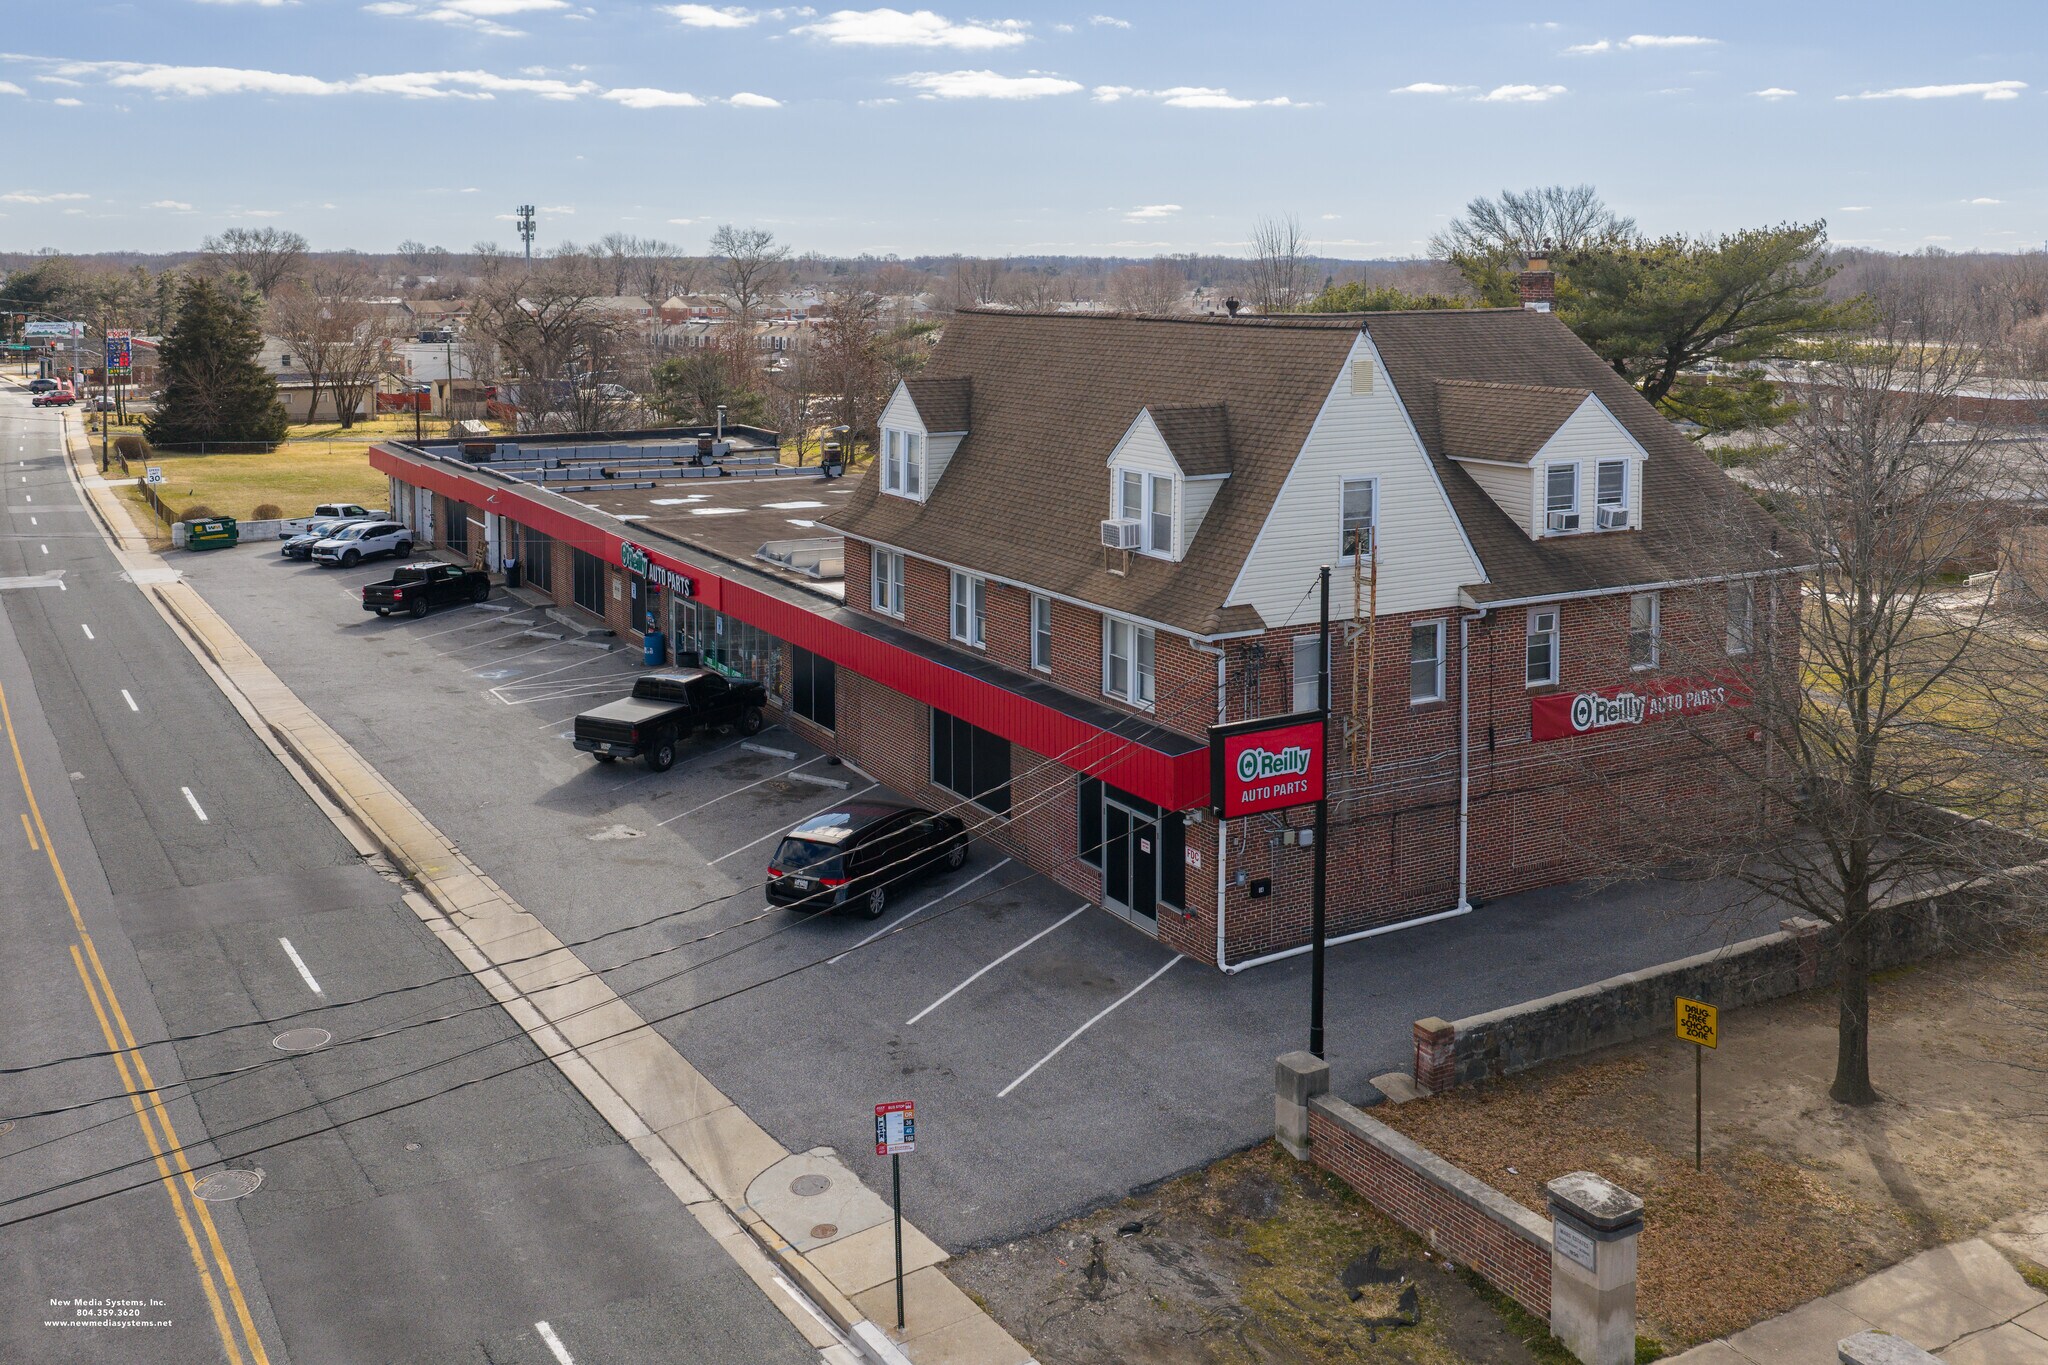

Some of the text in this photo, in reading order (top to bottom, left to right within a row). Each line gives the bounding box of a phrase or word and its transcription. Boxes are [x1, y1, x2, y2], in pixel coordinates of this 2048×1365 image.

[649, 564, 666, 586] AUTO
[667, 571, 690, 598] PARTS
[1649, 694, 1683, 715] AUTO
[1686, 687, 1725, 708] PARTS
[1238, 747, 1310, 781] O'Reilly
[1241, 779, 1308, 803] AUTO PARTS
[1187, 848, 1200, 862] FDC
[1681, 1019, 1714, 1035] SCHOOL
[1688, 1013, 1707, 1025] FREE
